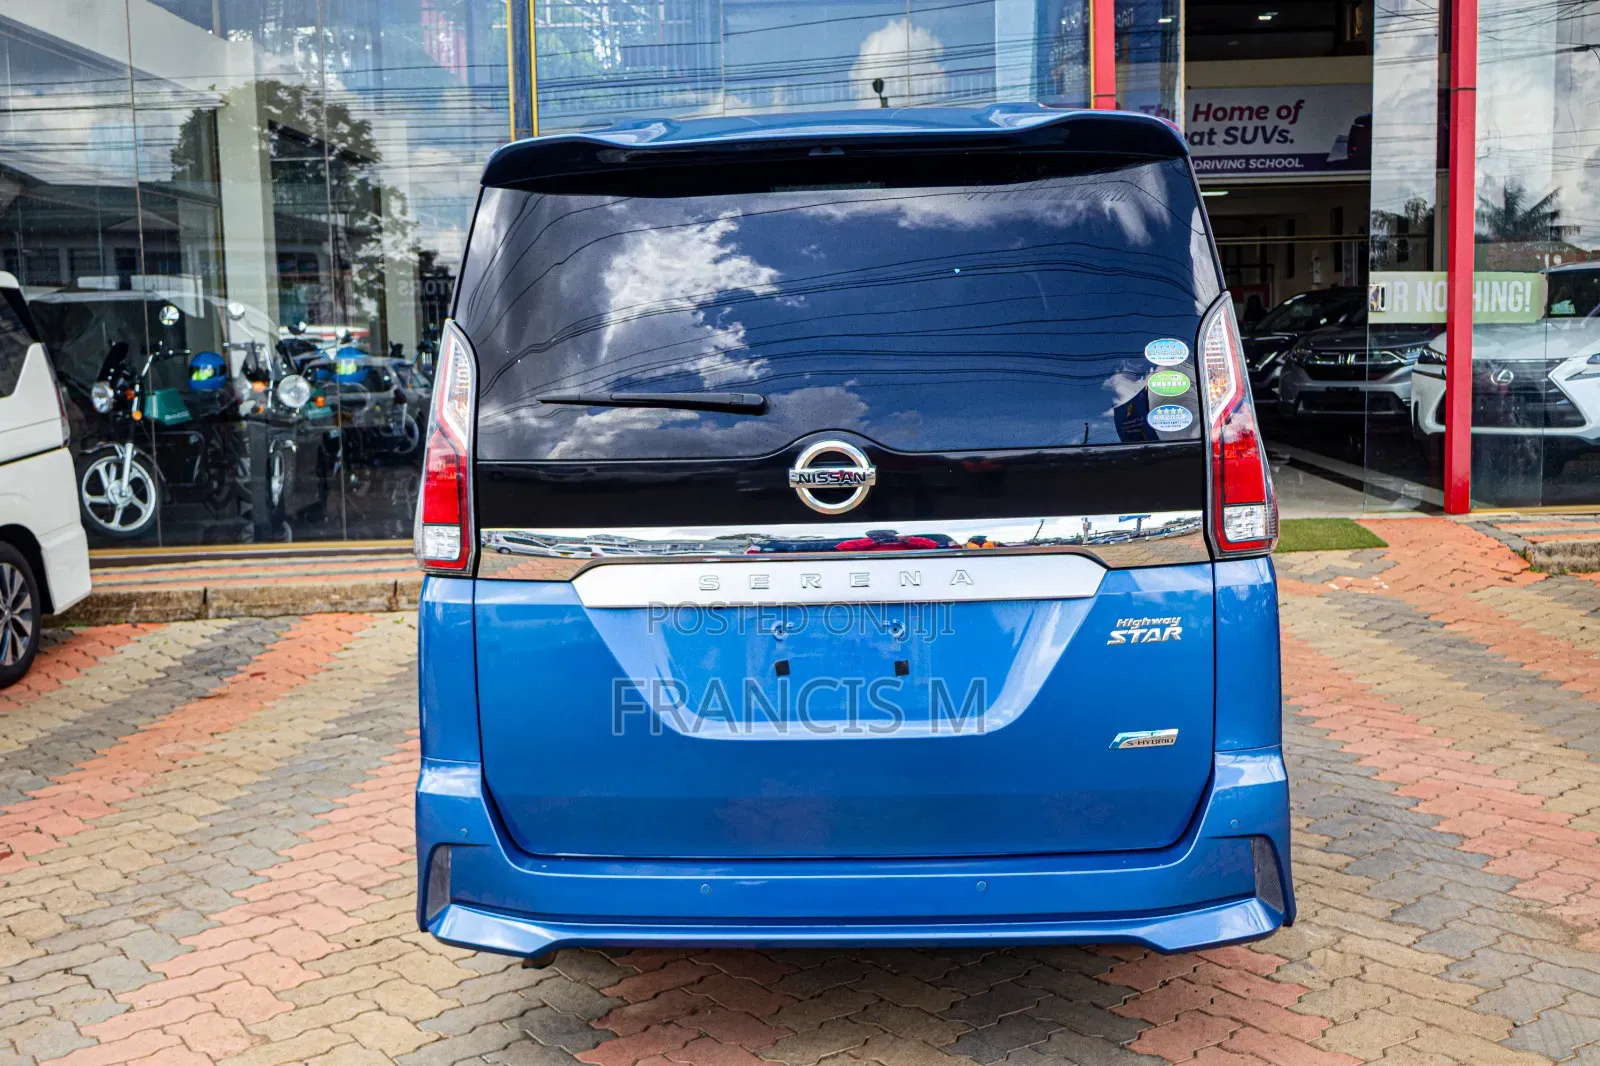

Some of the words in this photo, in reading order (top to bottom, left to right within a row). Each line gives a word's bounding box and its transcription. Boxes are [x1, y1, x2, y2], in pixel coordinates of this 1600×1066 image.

[1191, 102, 1268, 123] Home
[1276, 99, 1305, 125] of
[1222, 125, 1295, 146] SUVs.
[1193, 159, 1246, 170] DRIVING
[1248, 157, 1304, 169] SCHOOL.
[1416, 279, 1533, 313] NOHING!
[798, 471, 867, 484] NISSAN
[699, 569, 974, 591] SERENA
[1116, 616, 1181, 629] Highway
[1106, 627, 1182, 645] STAR
